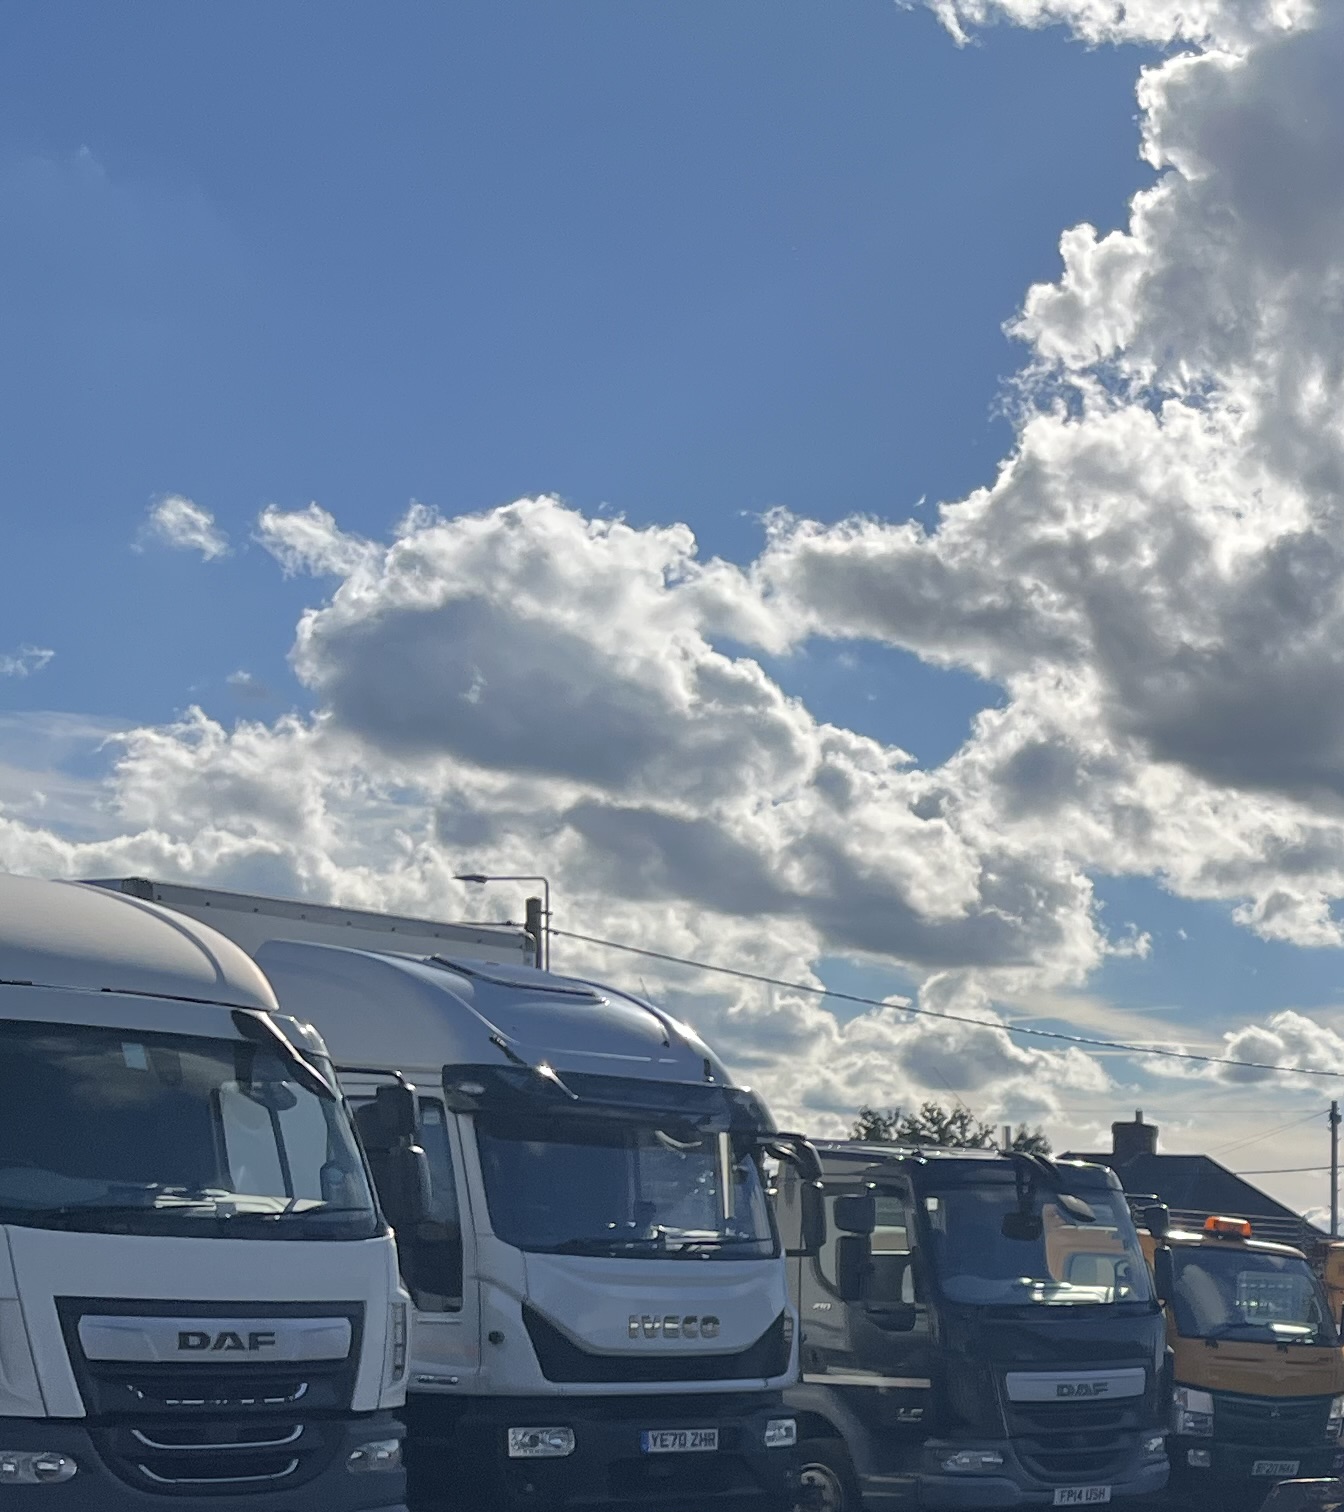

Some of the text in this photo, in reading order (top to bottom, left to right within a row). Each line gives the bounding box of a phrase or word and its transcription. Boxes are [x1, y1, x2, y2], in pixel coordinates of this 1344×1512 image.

[628, 1315, 720, 1339] IVECO
[177, 1331, 276, 1352] DAF
[1056, 1382, 1109, 1397] DAF
[651, 1432, 687, 1448] YE70
